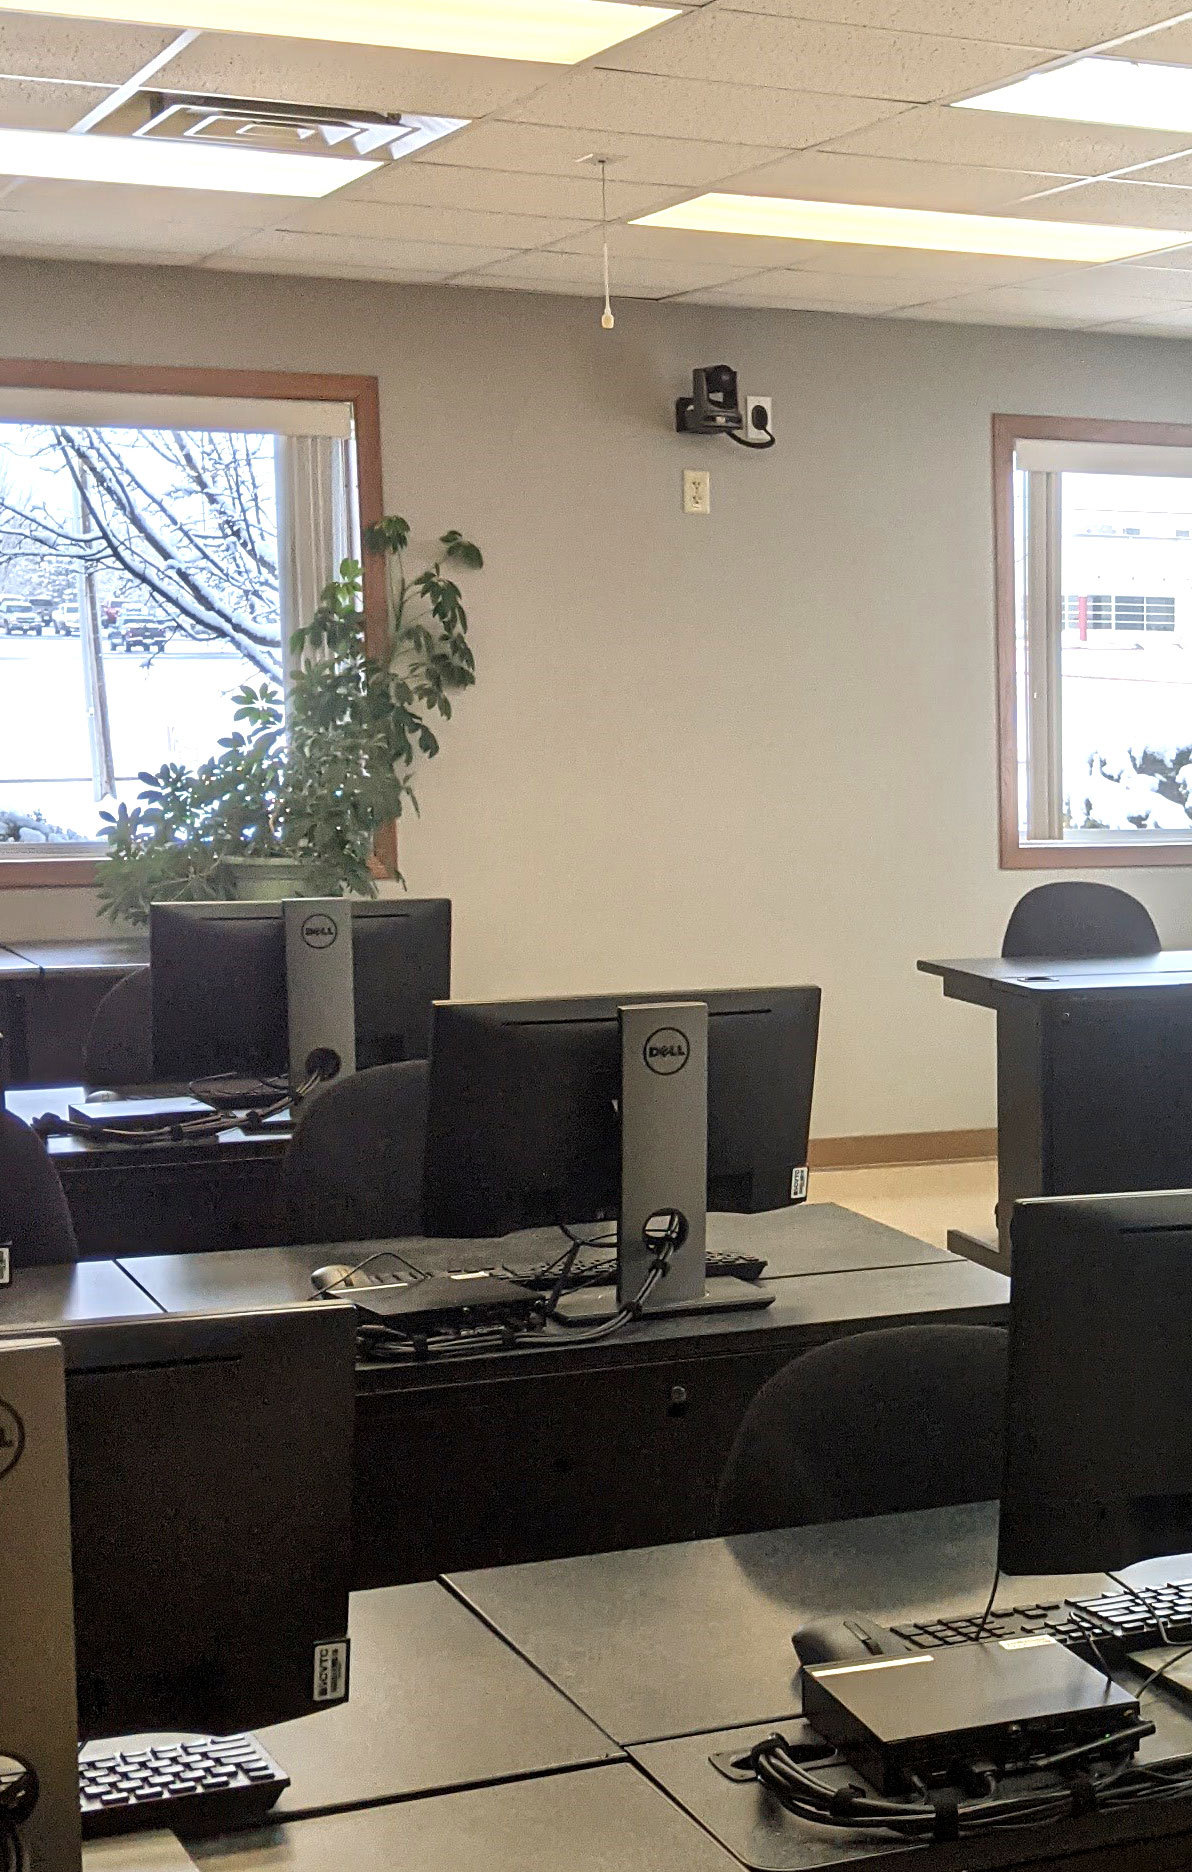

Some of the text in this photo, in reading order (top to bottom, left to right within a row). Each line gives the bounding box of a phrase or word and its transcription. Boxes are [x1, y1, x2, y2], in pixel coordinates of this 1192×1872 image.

[305, 927, 333, 936] DELL
[648, 1045, 685, 1058] DELL
[319, 1648, 329, 1681] CVTC
